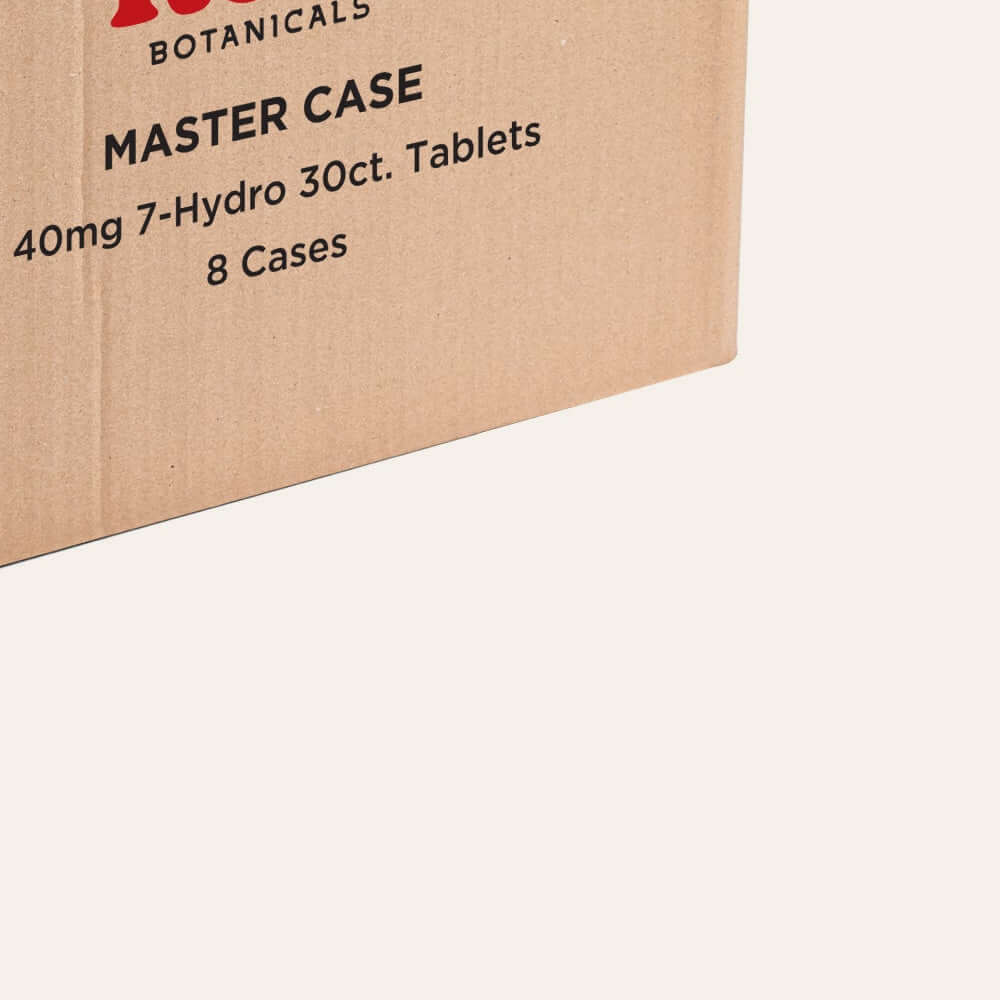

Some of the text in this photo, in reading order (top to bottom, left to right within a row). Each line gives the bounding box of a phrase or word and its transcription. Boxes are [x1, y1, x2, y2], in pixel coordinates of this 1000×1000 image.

[103, 63, 424, 171] MASTER CASE
[12, 121, 542, 261] 40mg 7-Hydro 30ct. Tablets
[207, 233, 348, 286] 8 Cases
